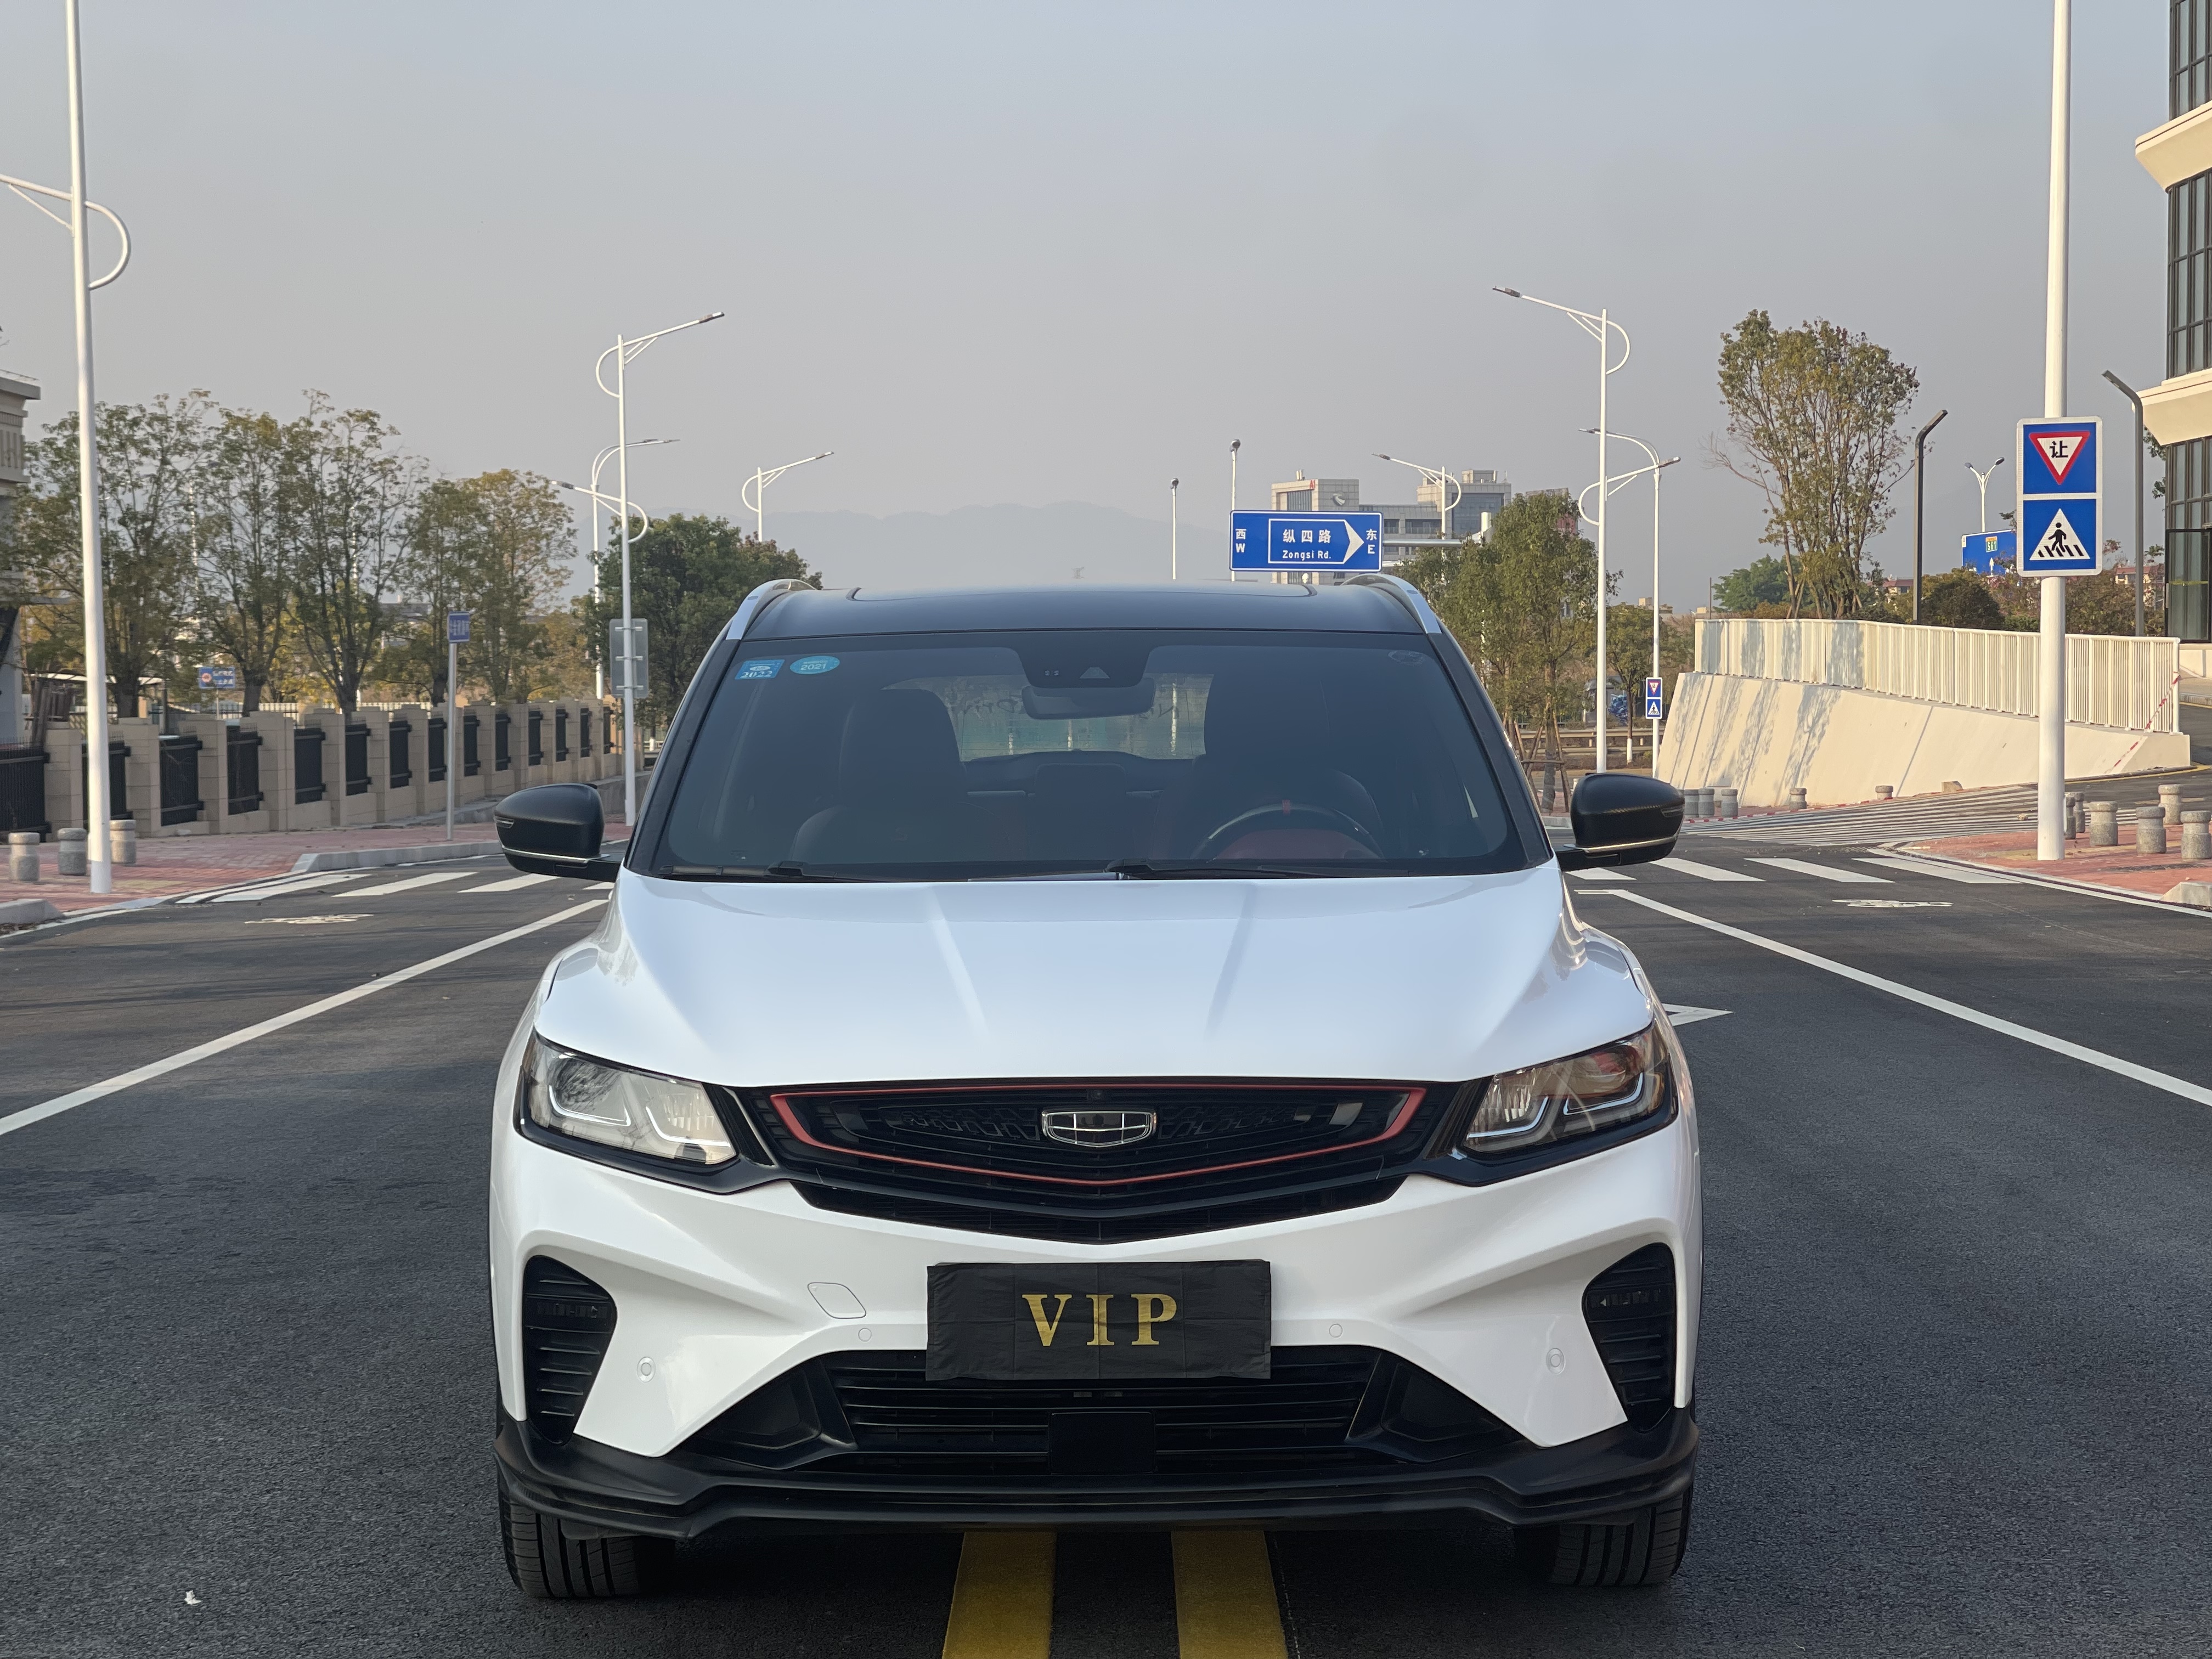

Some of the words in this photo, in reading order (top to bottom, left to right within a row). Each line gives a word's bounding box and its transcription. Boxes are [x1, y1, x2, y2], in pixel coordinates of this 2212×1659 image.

[2049, 441, 2069, 459] 让
[1235, 528, 1246, 540] 西
[1283, 529, 1331, 543] 纵四路
[1366, 529, 1377, 540] 东
[1235, 543, 1246, 553] W
[1368, 544, 1375, 555] E
[1282, 550, 1314, 561] Zongsi
[1317, 550, 1331, 559] Rd.
[1022, 1294, 1177, 1346] VIP
